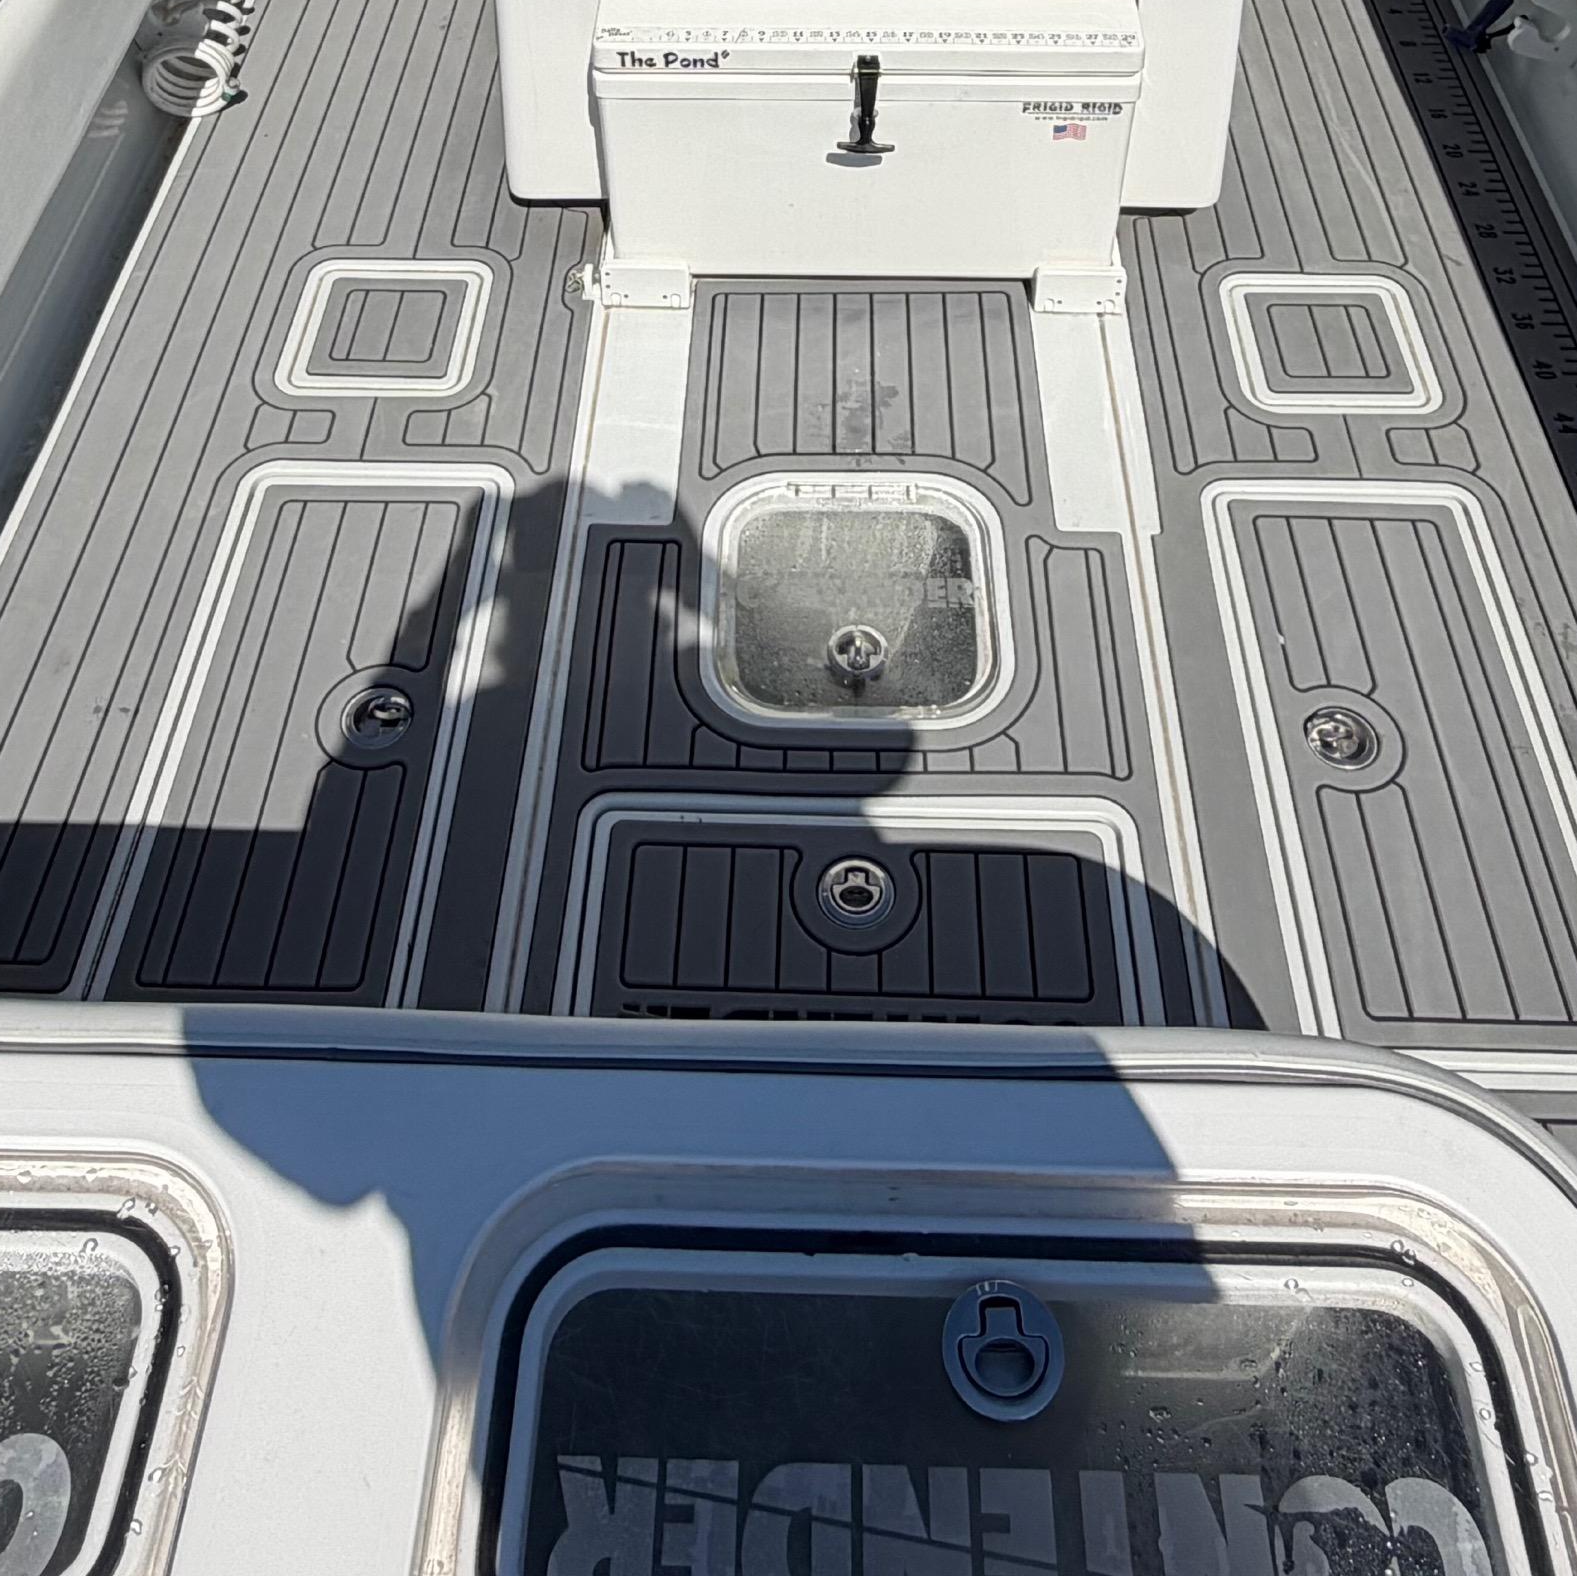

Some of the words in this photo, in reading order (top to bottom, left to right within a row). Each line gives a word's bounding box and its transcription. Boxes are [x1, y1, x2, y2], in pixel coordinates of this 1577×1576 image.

[616, 51, 656, 67] The
[1022, 103, 1074, 113] FRIGID
[1081, 103, 1123, 115] RIGID
[1442, 143, 1464, 159] 20
[1458, 181, 1480, 197] 24
[1475, 224, 1498, 239] 28
[1493, 267, 1516, 285] 32
[1511, 312, 1535, 330] 36
[1533, 359, 1557, 380] 40
